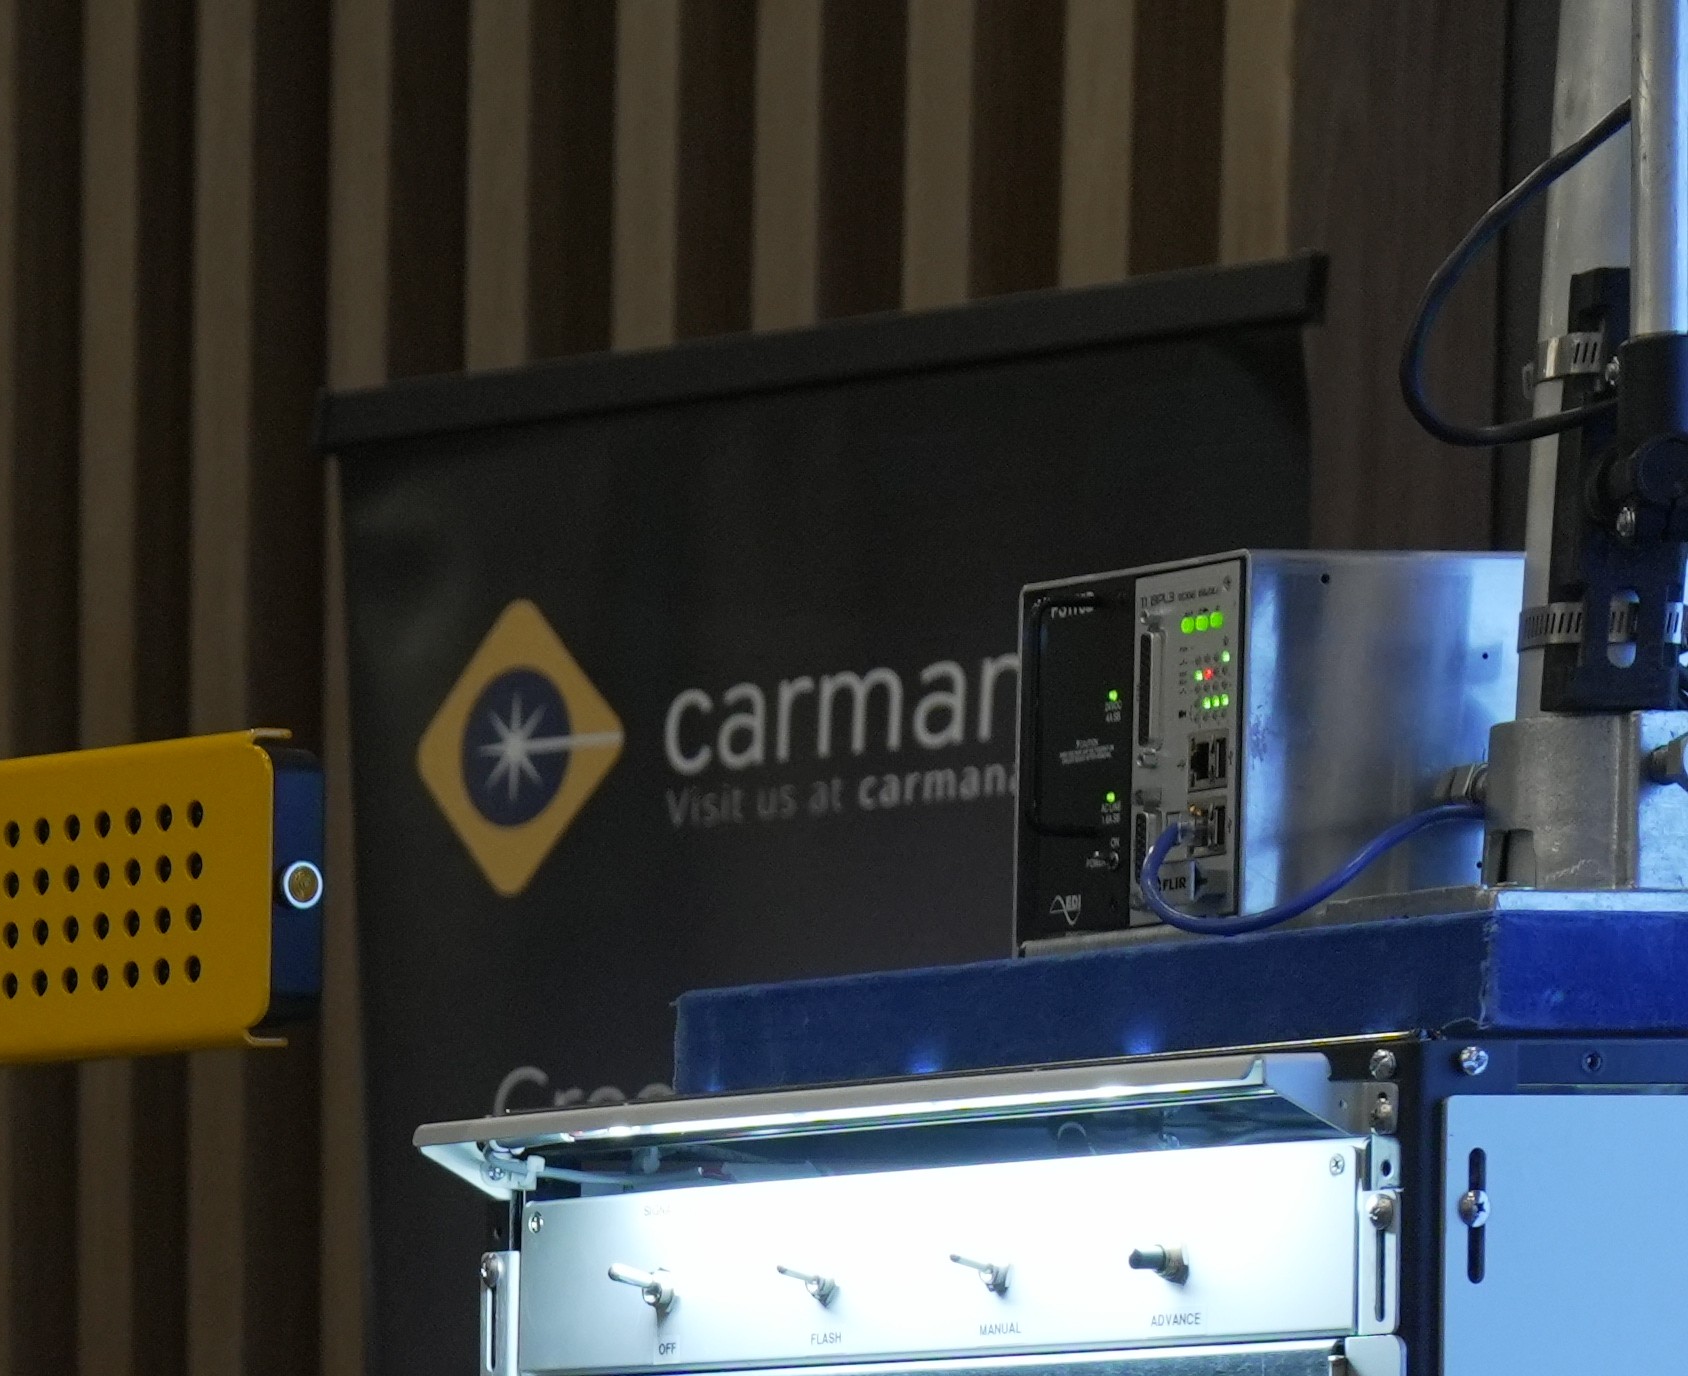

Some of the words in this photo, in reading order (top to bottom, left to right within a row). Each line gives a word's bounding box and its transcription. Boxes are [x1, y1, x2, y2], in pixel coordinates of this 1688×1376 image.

[666, 786, 741, 828] Visit
[756, 783, 795, 816] us
[809, 775, 844, 813] at
[858, 764, 1017, 810] carman
[1162, 877, 1186, 890] FLIR
[1150, 1312, 1202, 1328] ADVANCE
[980, 1322, 1022, 1337] MANUAL
[810, 1332, 842, 1346] FLASH
[658, 1343, 676, 1355] OFF
